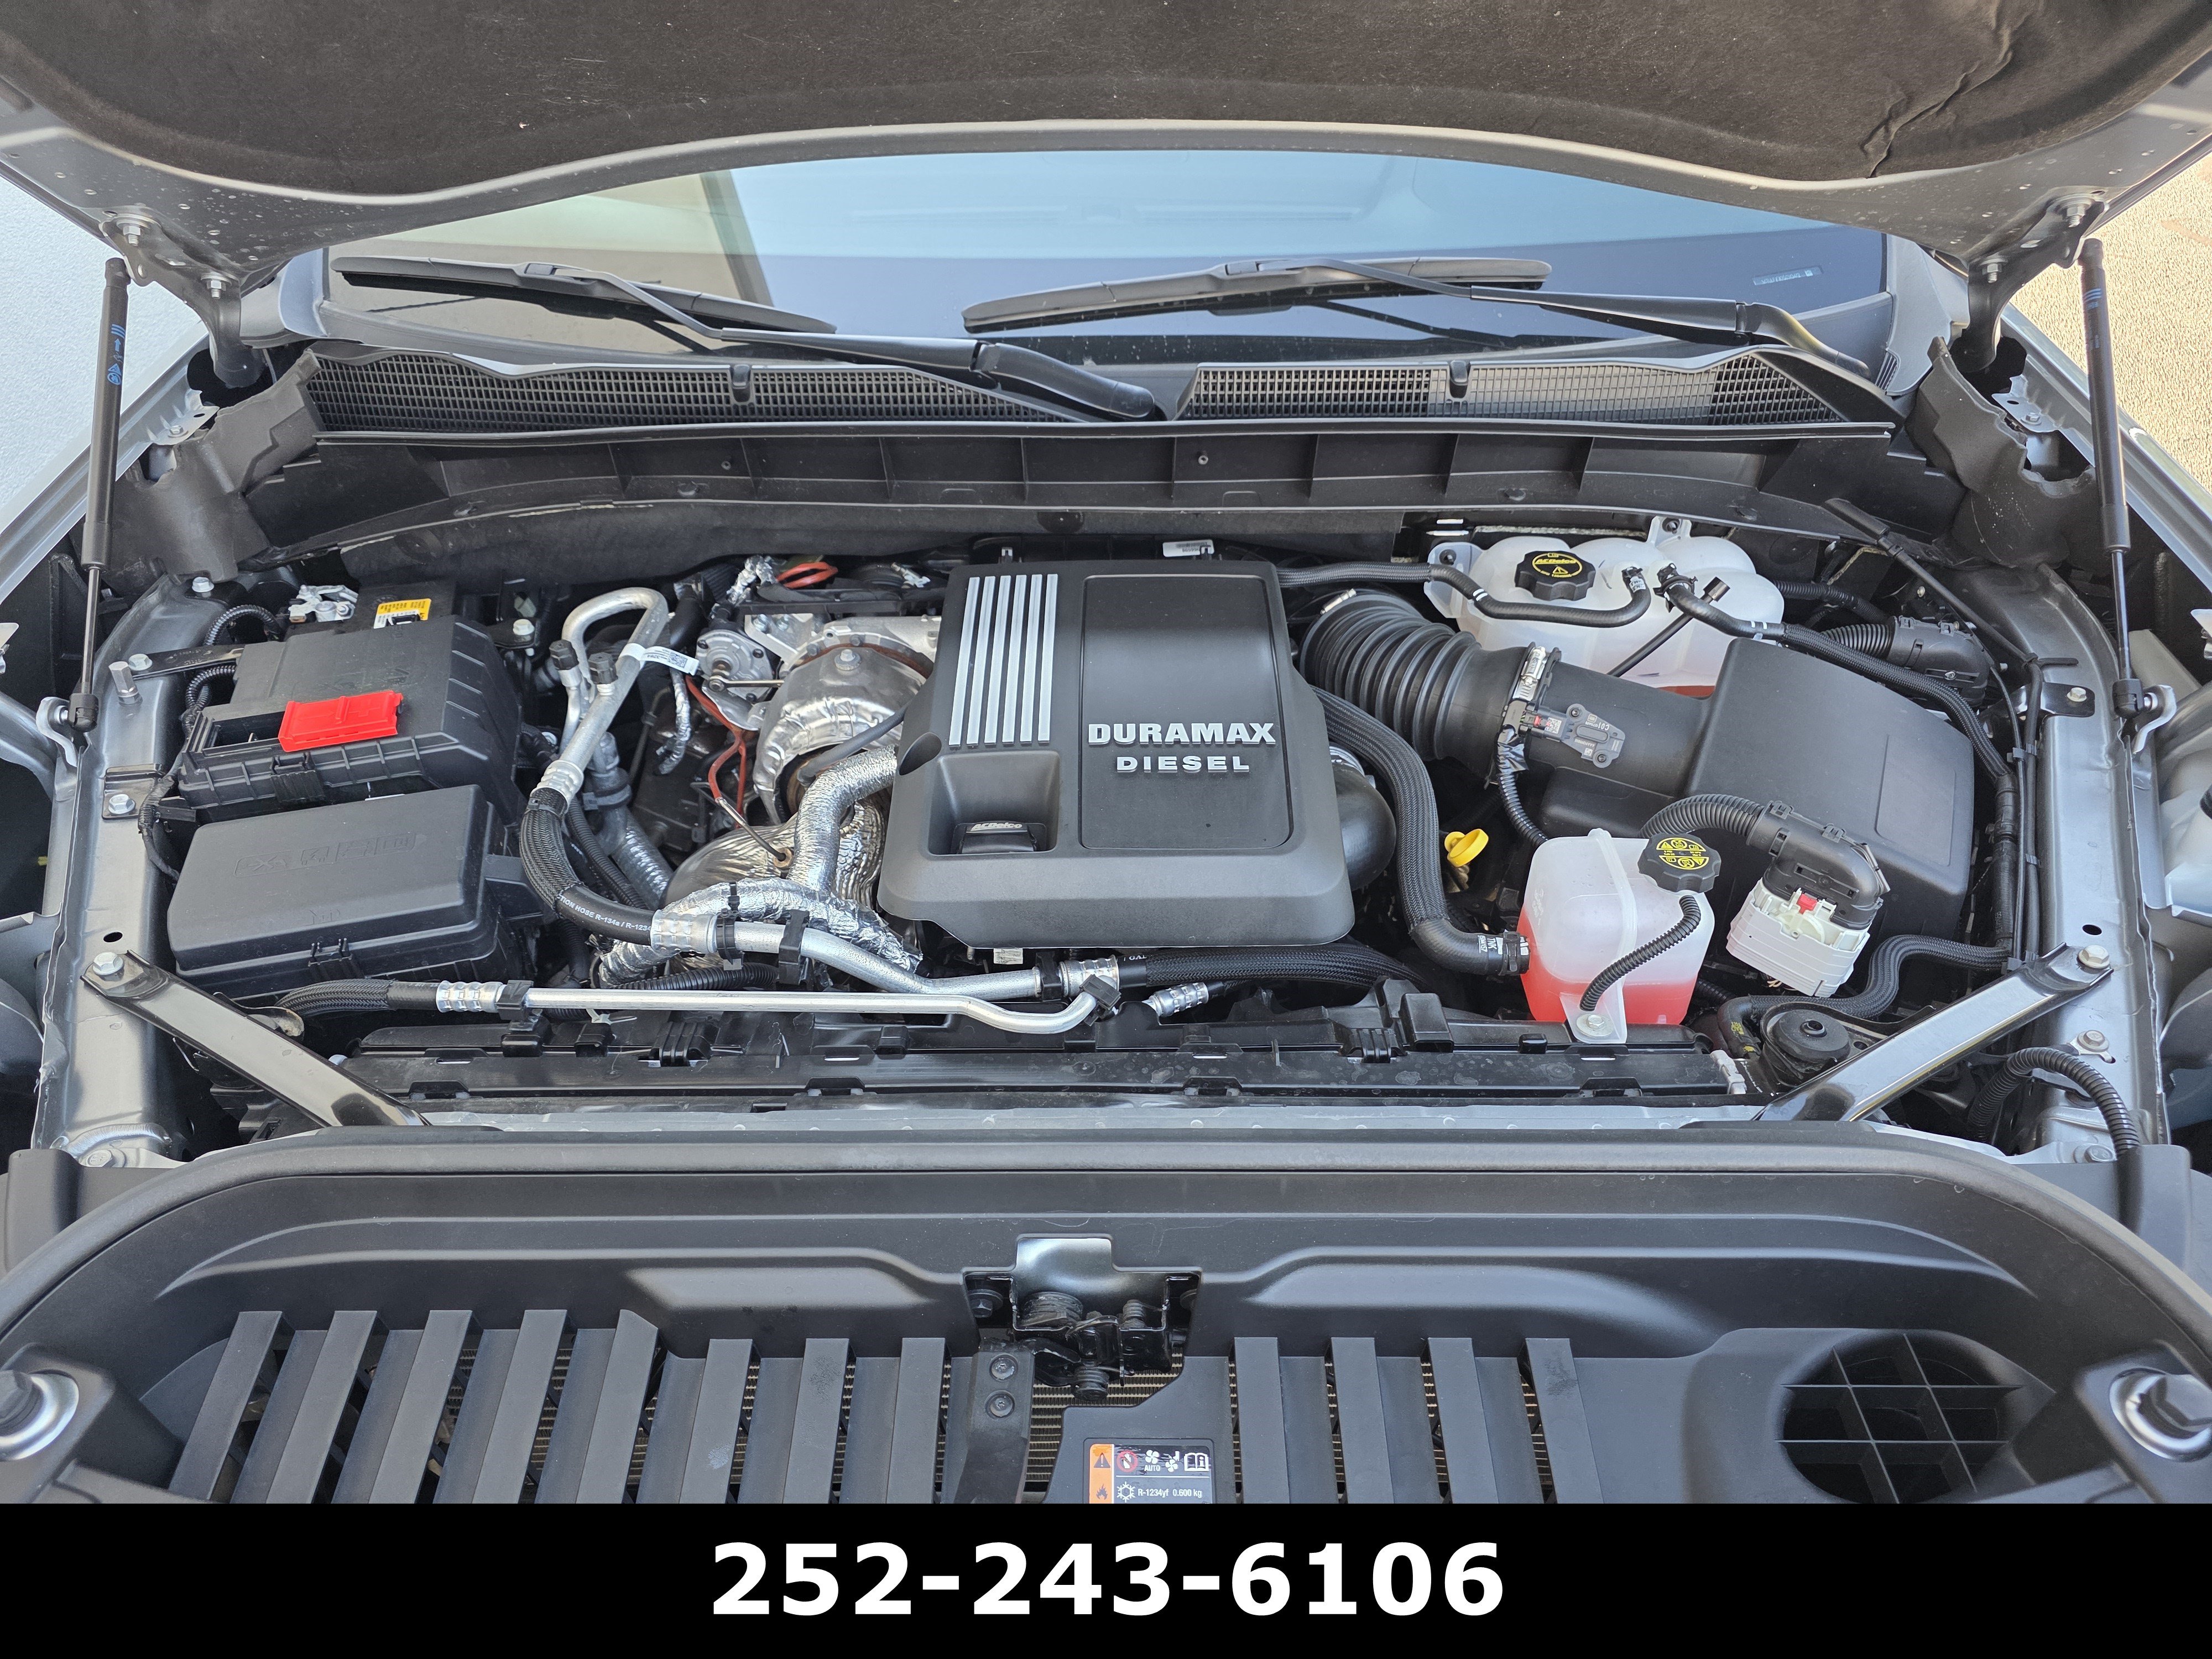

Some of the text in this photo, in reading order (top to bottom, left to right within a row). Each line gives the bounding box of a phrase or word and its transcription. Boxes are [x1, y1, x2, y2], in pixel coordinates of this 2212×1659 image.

[1088, 722, 1276, 745] DURAMAX
[1117, 755, 1250, 773] DIESEL
[970, 822, 1022, 832] ACDelco
[575, 905, 596, 918] HOSE
[594, 914, 620, 926] R-134a
[1486, 938, 1498, 950] TNK
[1138, 1488, 1203, 1499] R-1234yf 0.600 kg
